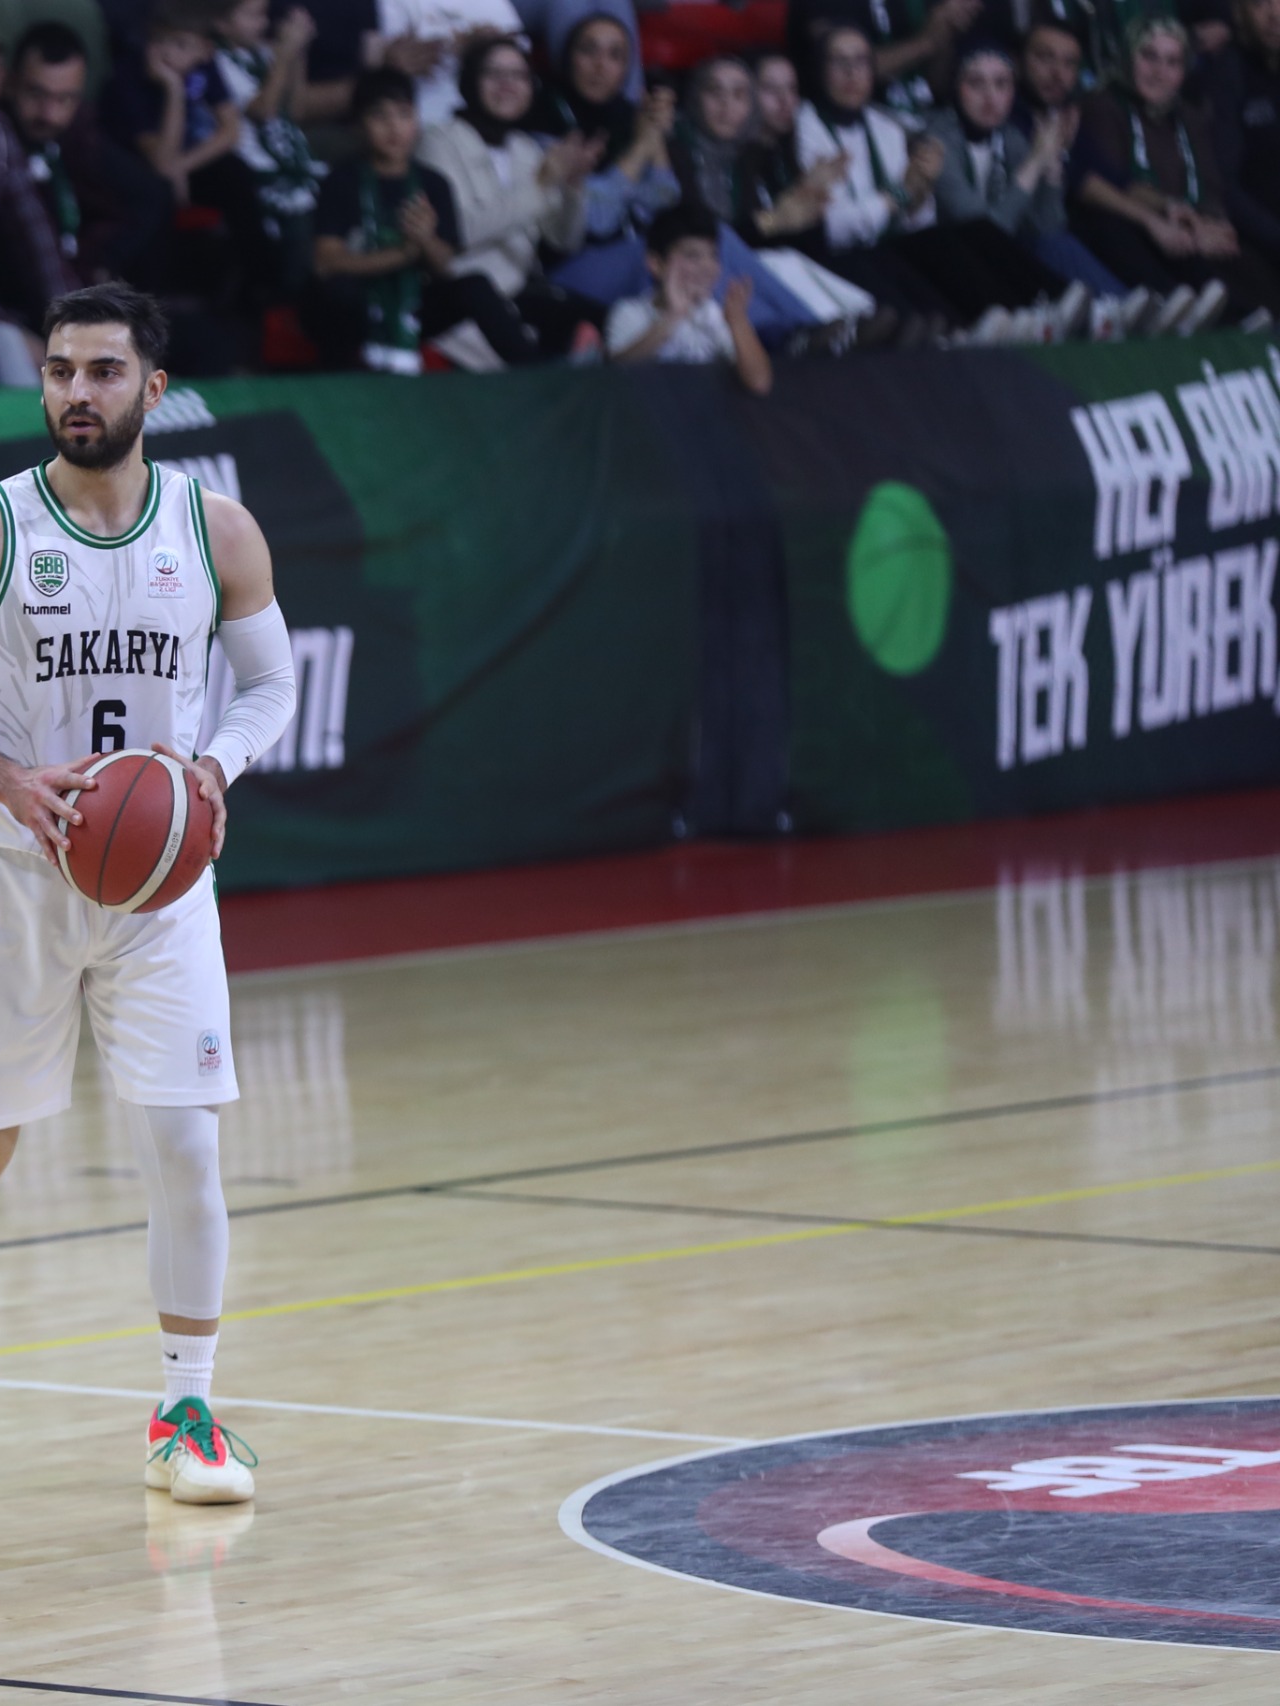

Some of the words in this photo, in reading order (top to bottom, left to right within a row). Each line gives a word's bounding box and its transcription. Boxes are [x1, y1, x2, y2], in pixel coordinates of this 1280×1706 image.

[1070, 390, 1192, 560] HEP
[1176, 343, 1280, 532] BİR
[34, 556, 65, 575] SBB
[23, 602, 71, 615] hummel
[36, 629, 179, 683] SAKARYA
[989, 585, 1094, 771] TEK
[91, 699, 127, 754] 6
